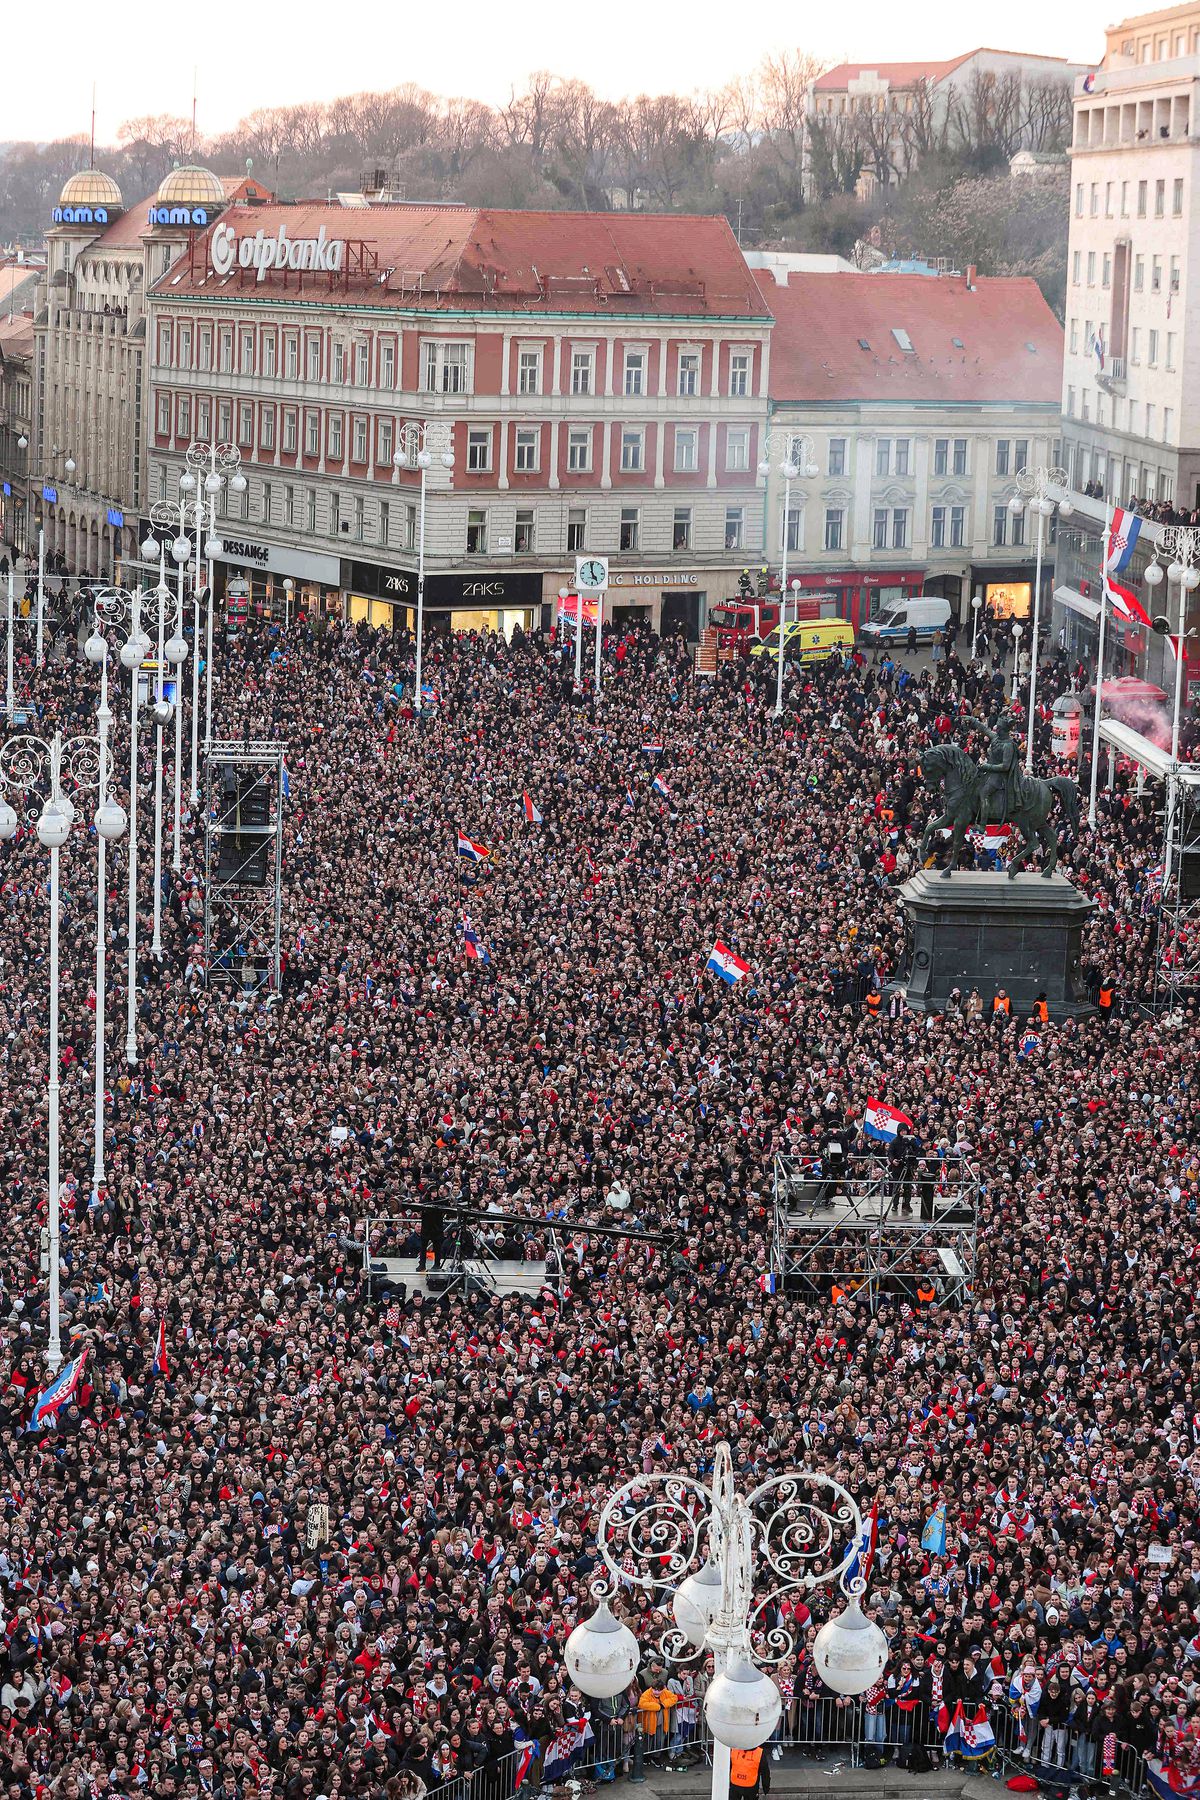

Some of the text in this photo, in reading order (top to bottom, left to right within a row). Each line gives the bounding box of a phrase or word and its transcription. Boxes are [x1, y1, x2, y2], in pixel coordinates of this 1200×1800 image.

[52, 207, 107, 223] nama
[223, 540, 269, 561] DESSANGE
[385, 575, 409, 593] ZAKS
[634, 574, 698, 585] HOLDING
[462, 582, 505, 597] ZAKS
